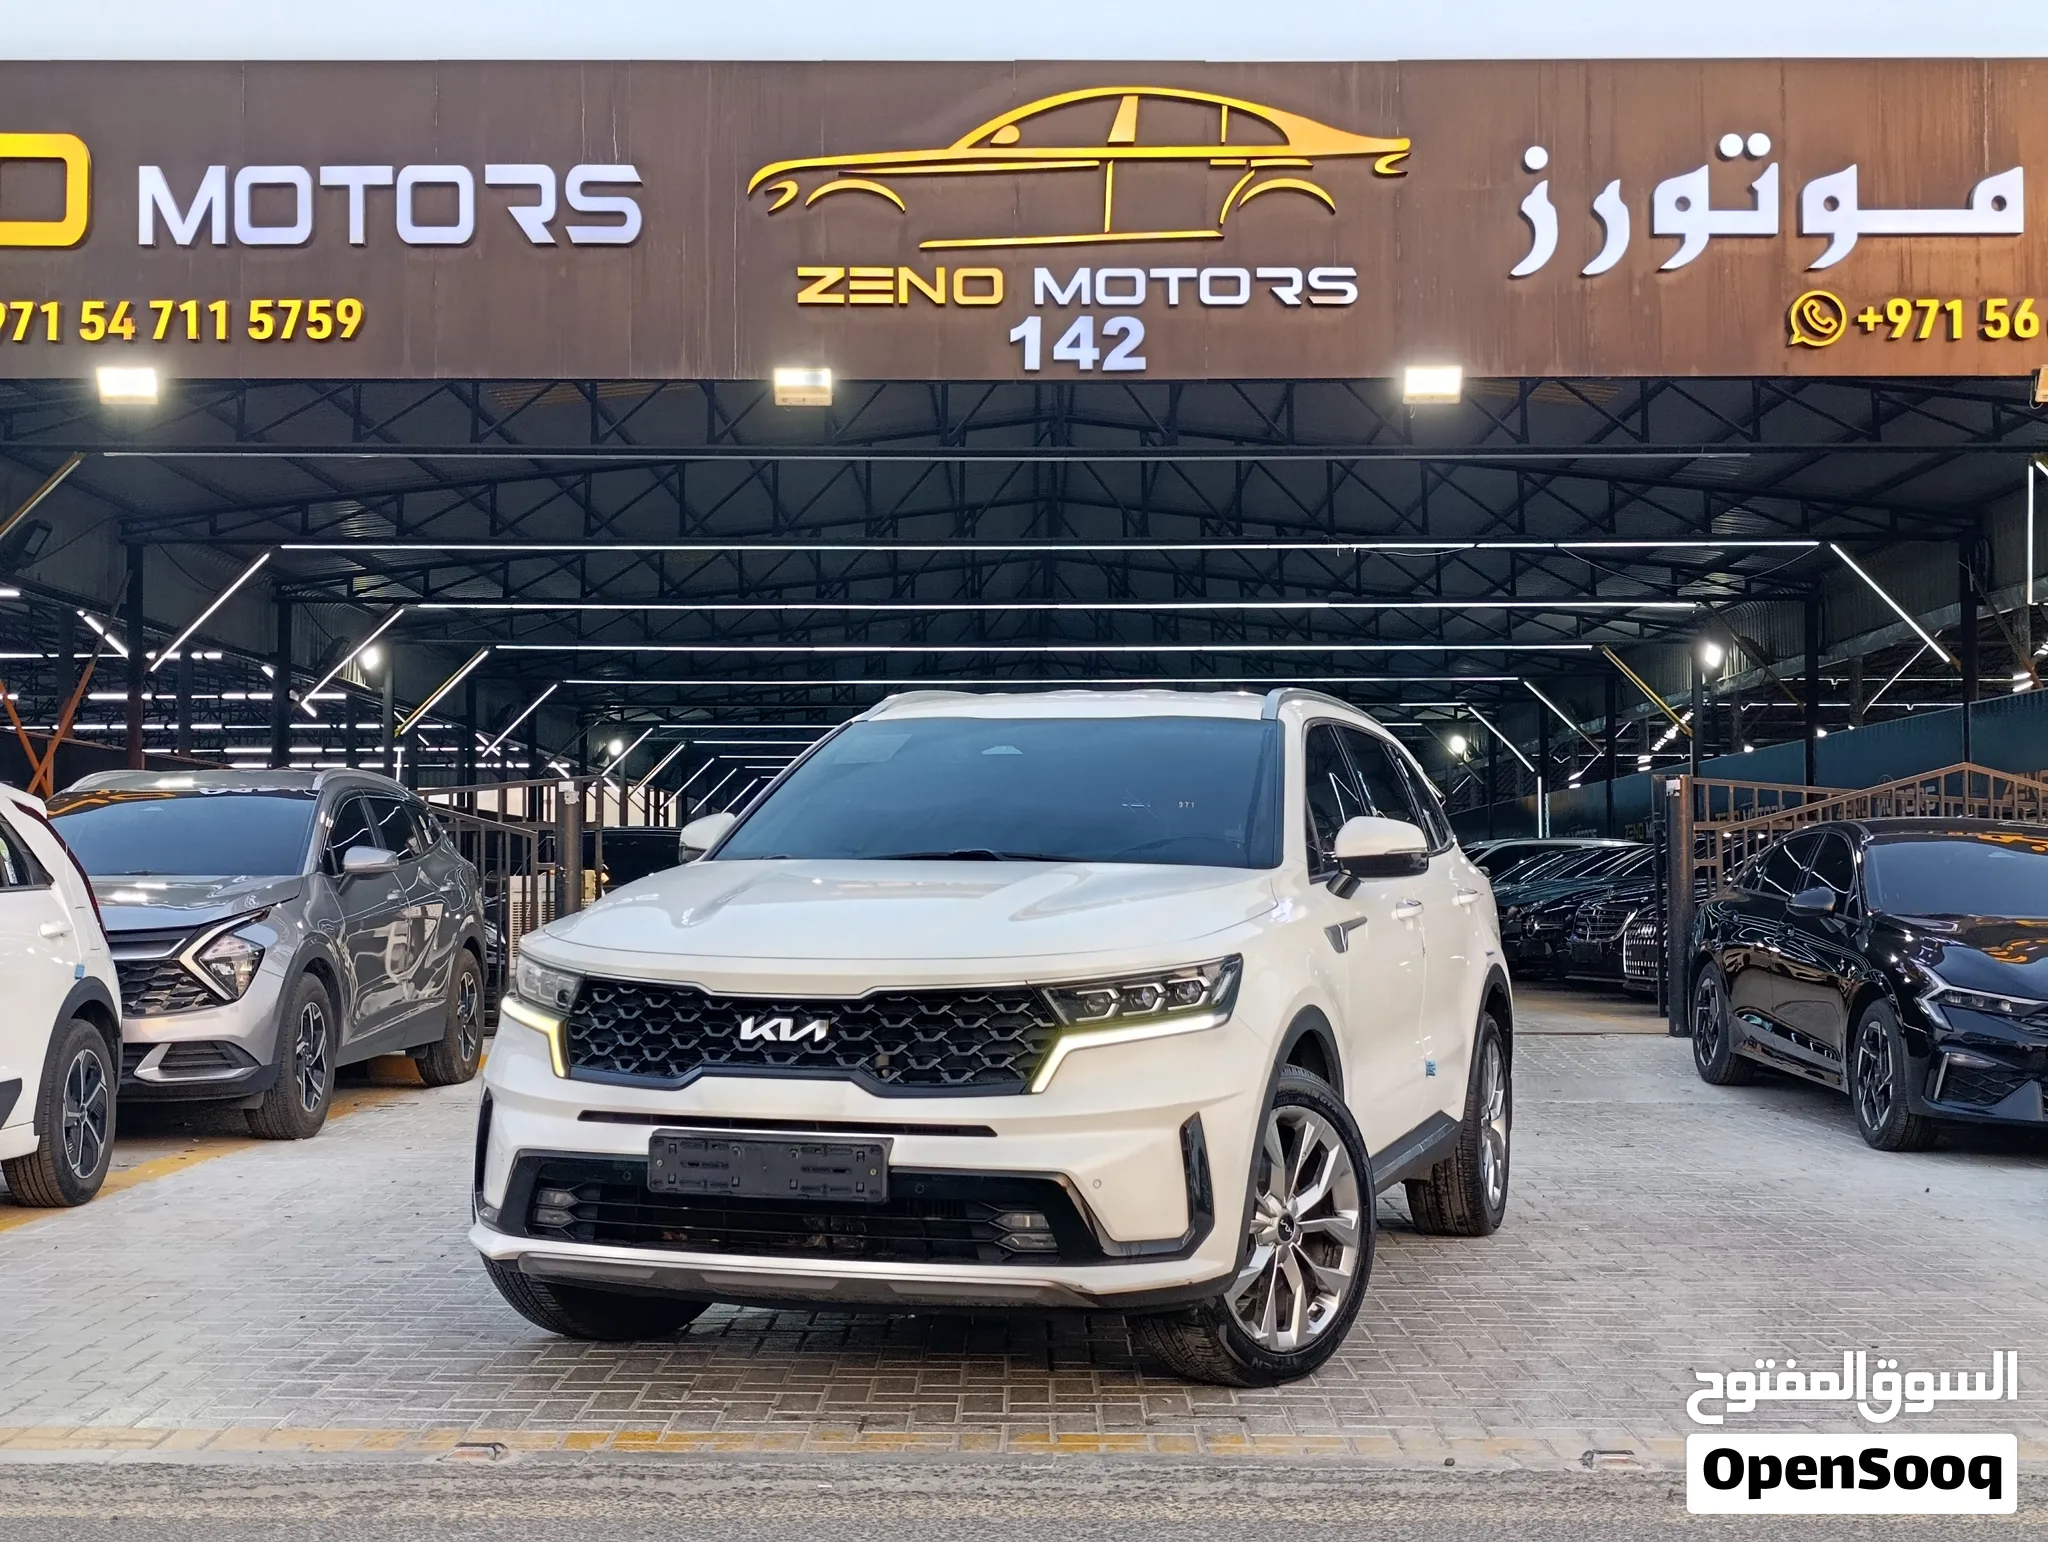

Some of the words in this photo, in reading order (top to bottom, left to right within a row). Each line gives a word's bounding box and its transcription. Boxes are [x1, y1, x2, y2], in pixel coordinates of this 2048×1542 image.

[138, 164, 643, 247] MOTORS
[1508, 132, 2024, 277] موتورز
[796, 266, 1004, 306] ZENO
[1033, 266, 1359, 306] MOTORS
[0, 300, 62, 342] 71
[79, 300, 136, 342] 54
[149, 299, 230, 341] 711
[247, 297, 366, 341] 5759
[1856, 297, 1963, 340] +971
[1982, 297, 2041, 339] 56
[1009, 315, 1148, 372] 142
[740, 1016, 829, 1042] KIA
